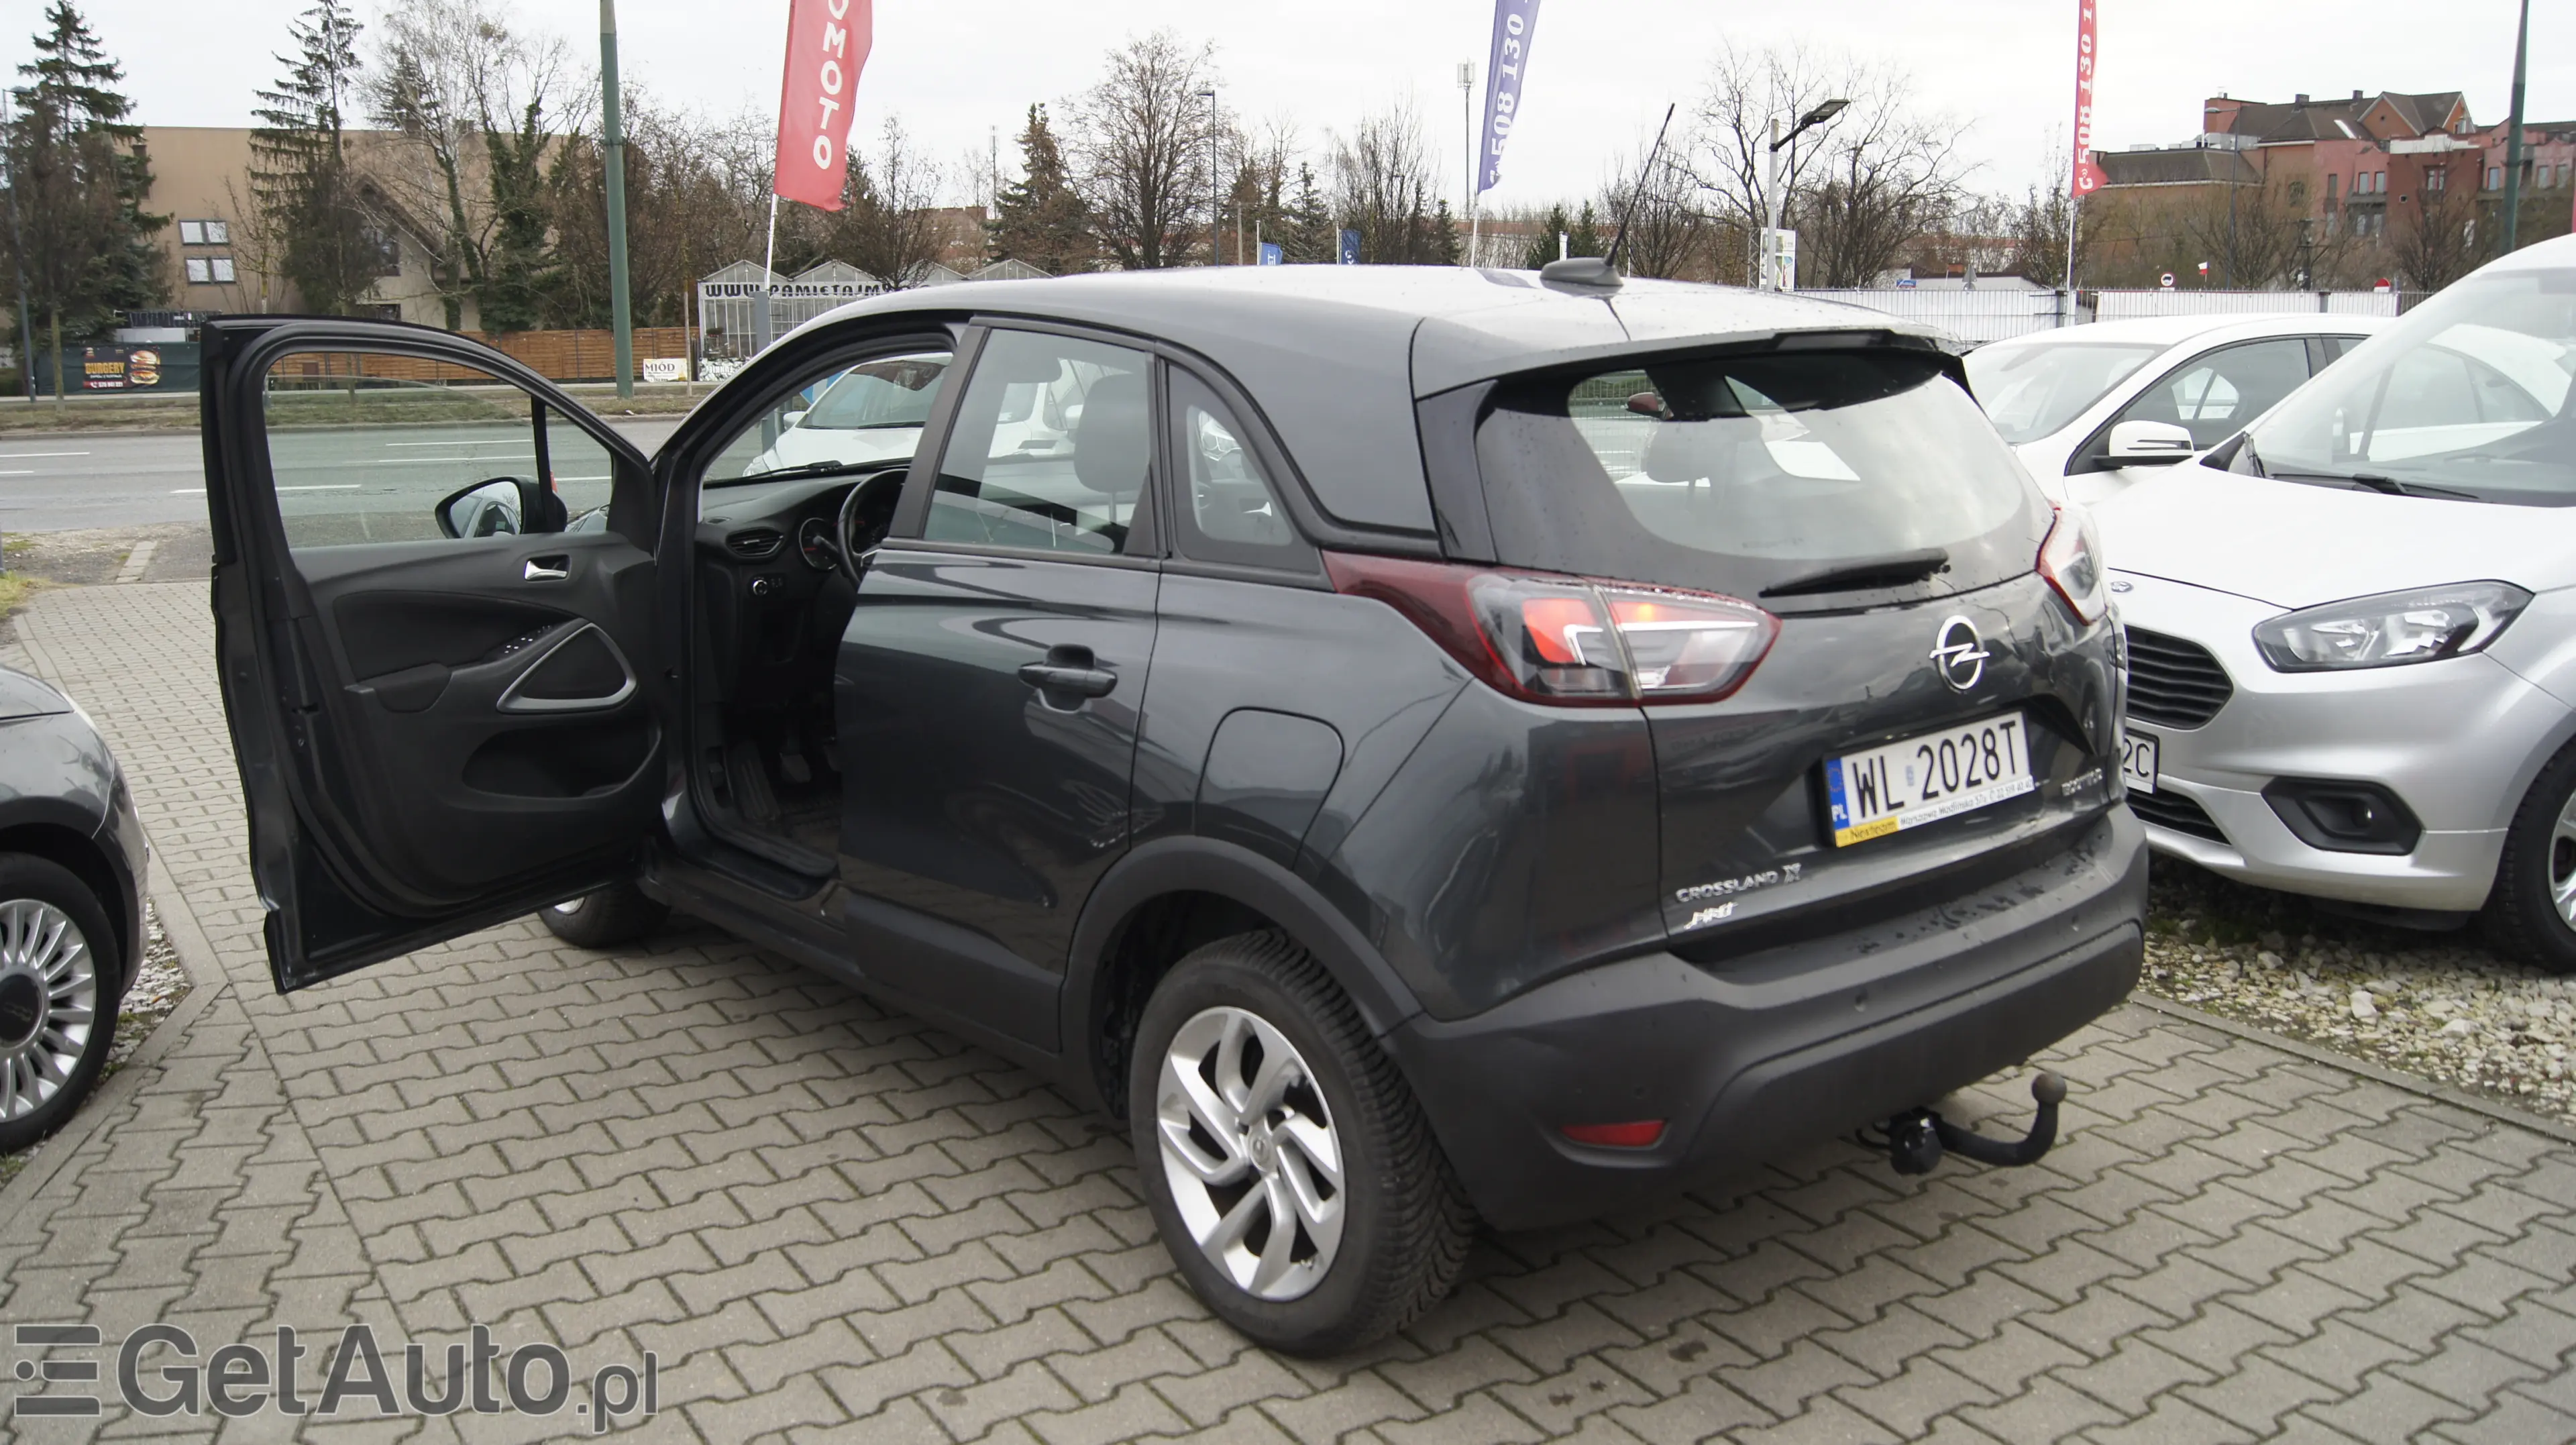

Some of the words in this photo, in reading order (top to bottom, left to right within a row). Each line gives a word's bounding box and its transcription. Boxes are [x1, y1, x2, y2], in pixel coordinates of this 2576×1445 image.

[1503, 13, 1523, 81] 130
[2080, 34, 2092, 95] 130
[2078, 105, 2092, 164] 508
[85, 362, 125, 374] BURGERY
[645, 362, 676, 372] MIÓD
[1852, 755, 1904, 818] WL
[1917, 720, 2017, 800] 2028T
[1831, 804, 1848, 822] PL
[1676, 871, 1778, 902] CROSSLAND
